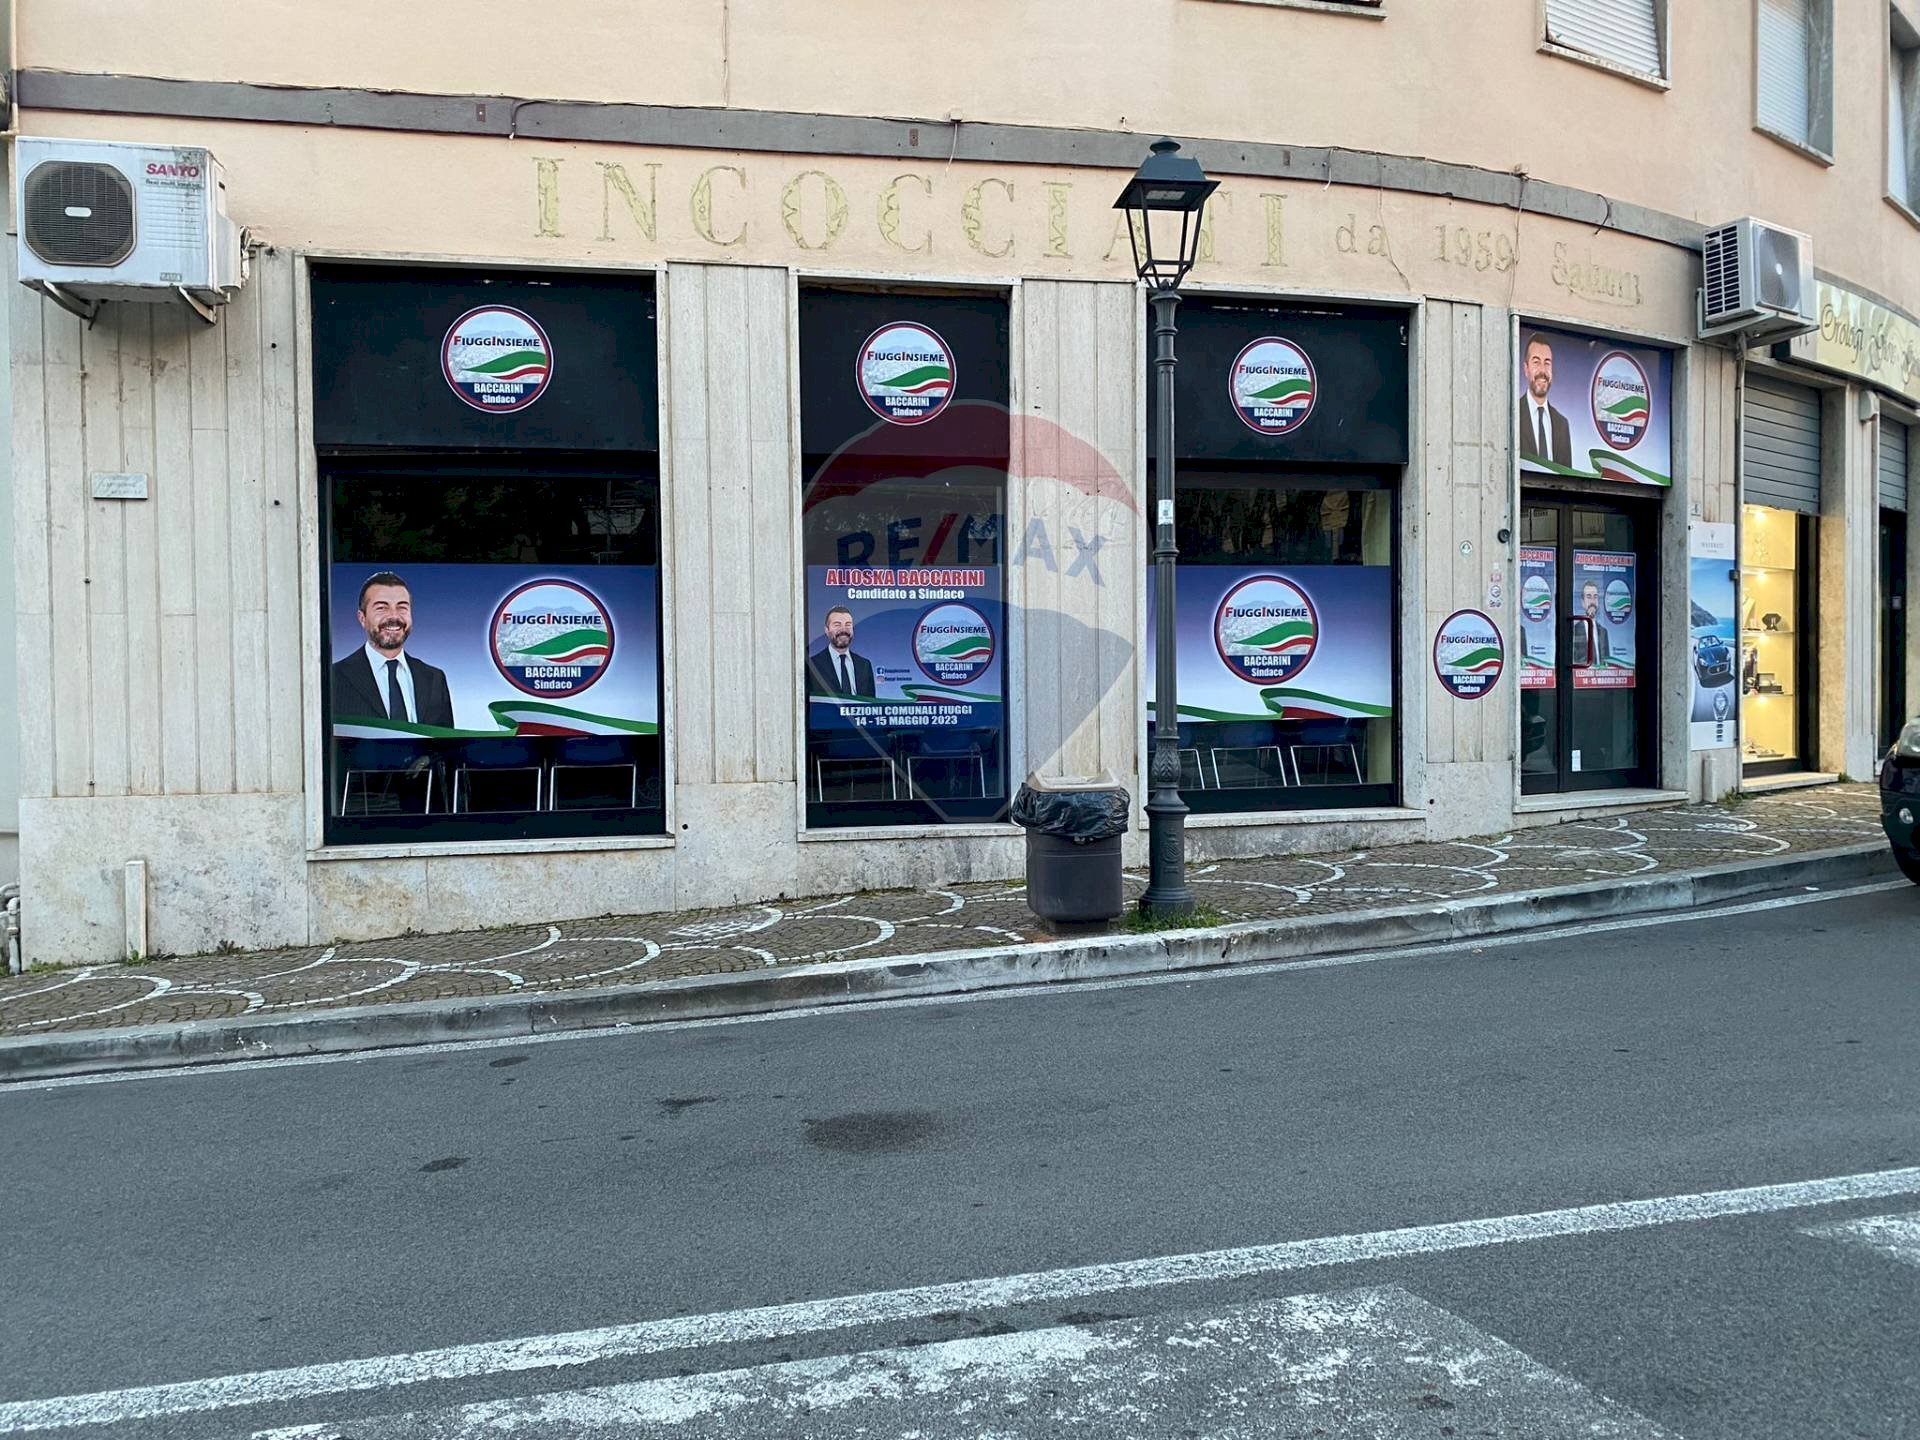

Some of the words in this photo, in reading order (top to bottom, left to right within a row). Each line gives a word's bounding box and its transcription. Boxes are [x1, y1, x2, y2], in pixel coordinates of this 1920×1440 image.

[146, 163, 199, 177] SANYO
[1335, 213, 1388, 257] da
[1433, 223, 1514, 273] 1959
[474, 383, 524, 394] BACCARINI
[482, 394, 516, 403] Sindaco
[885, 396, 930, 407] BACCARINI
[892, 407, 923, 416] Sindaco
[1254, 408, 1293, 417] BACCARINI
[1260, 418, 1287, 426] Sindaco
[826, 569, 895, 586] ALIOSKA
[897, 569, 985, 587] BACCARINI
[848, 588, 907, 600] Candidato
[909, 590, 916, 600] a
[918, 588, 965, 600] Sindaco
[1244, 655, 1291, 666] BACCARINI
[525, 667, 582, 678] BACCARINI
[935, 663, 973, 672] BACCARINI
[1251, 667, 1284, 677] Sindaco
[941, 672, 968, 680] Sindaco
[534, 679, 573, 690] Sindaco
[840, 706, 883, 716] ELEZIONI
[884, 705, 937, 715] COMUNALI
[938, 705, 973, 714] FIUGGI
[855, 716, 867, 726] 14
[874, 716, 887, 726] 15
[889, 716, 929, 726] MAGGIO
[931, 715, 958, 725] 2023
